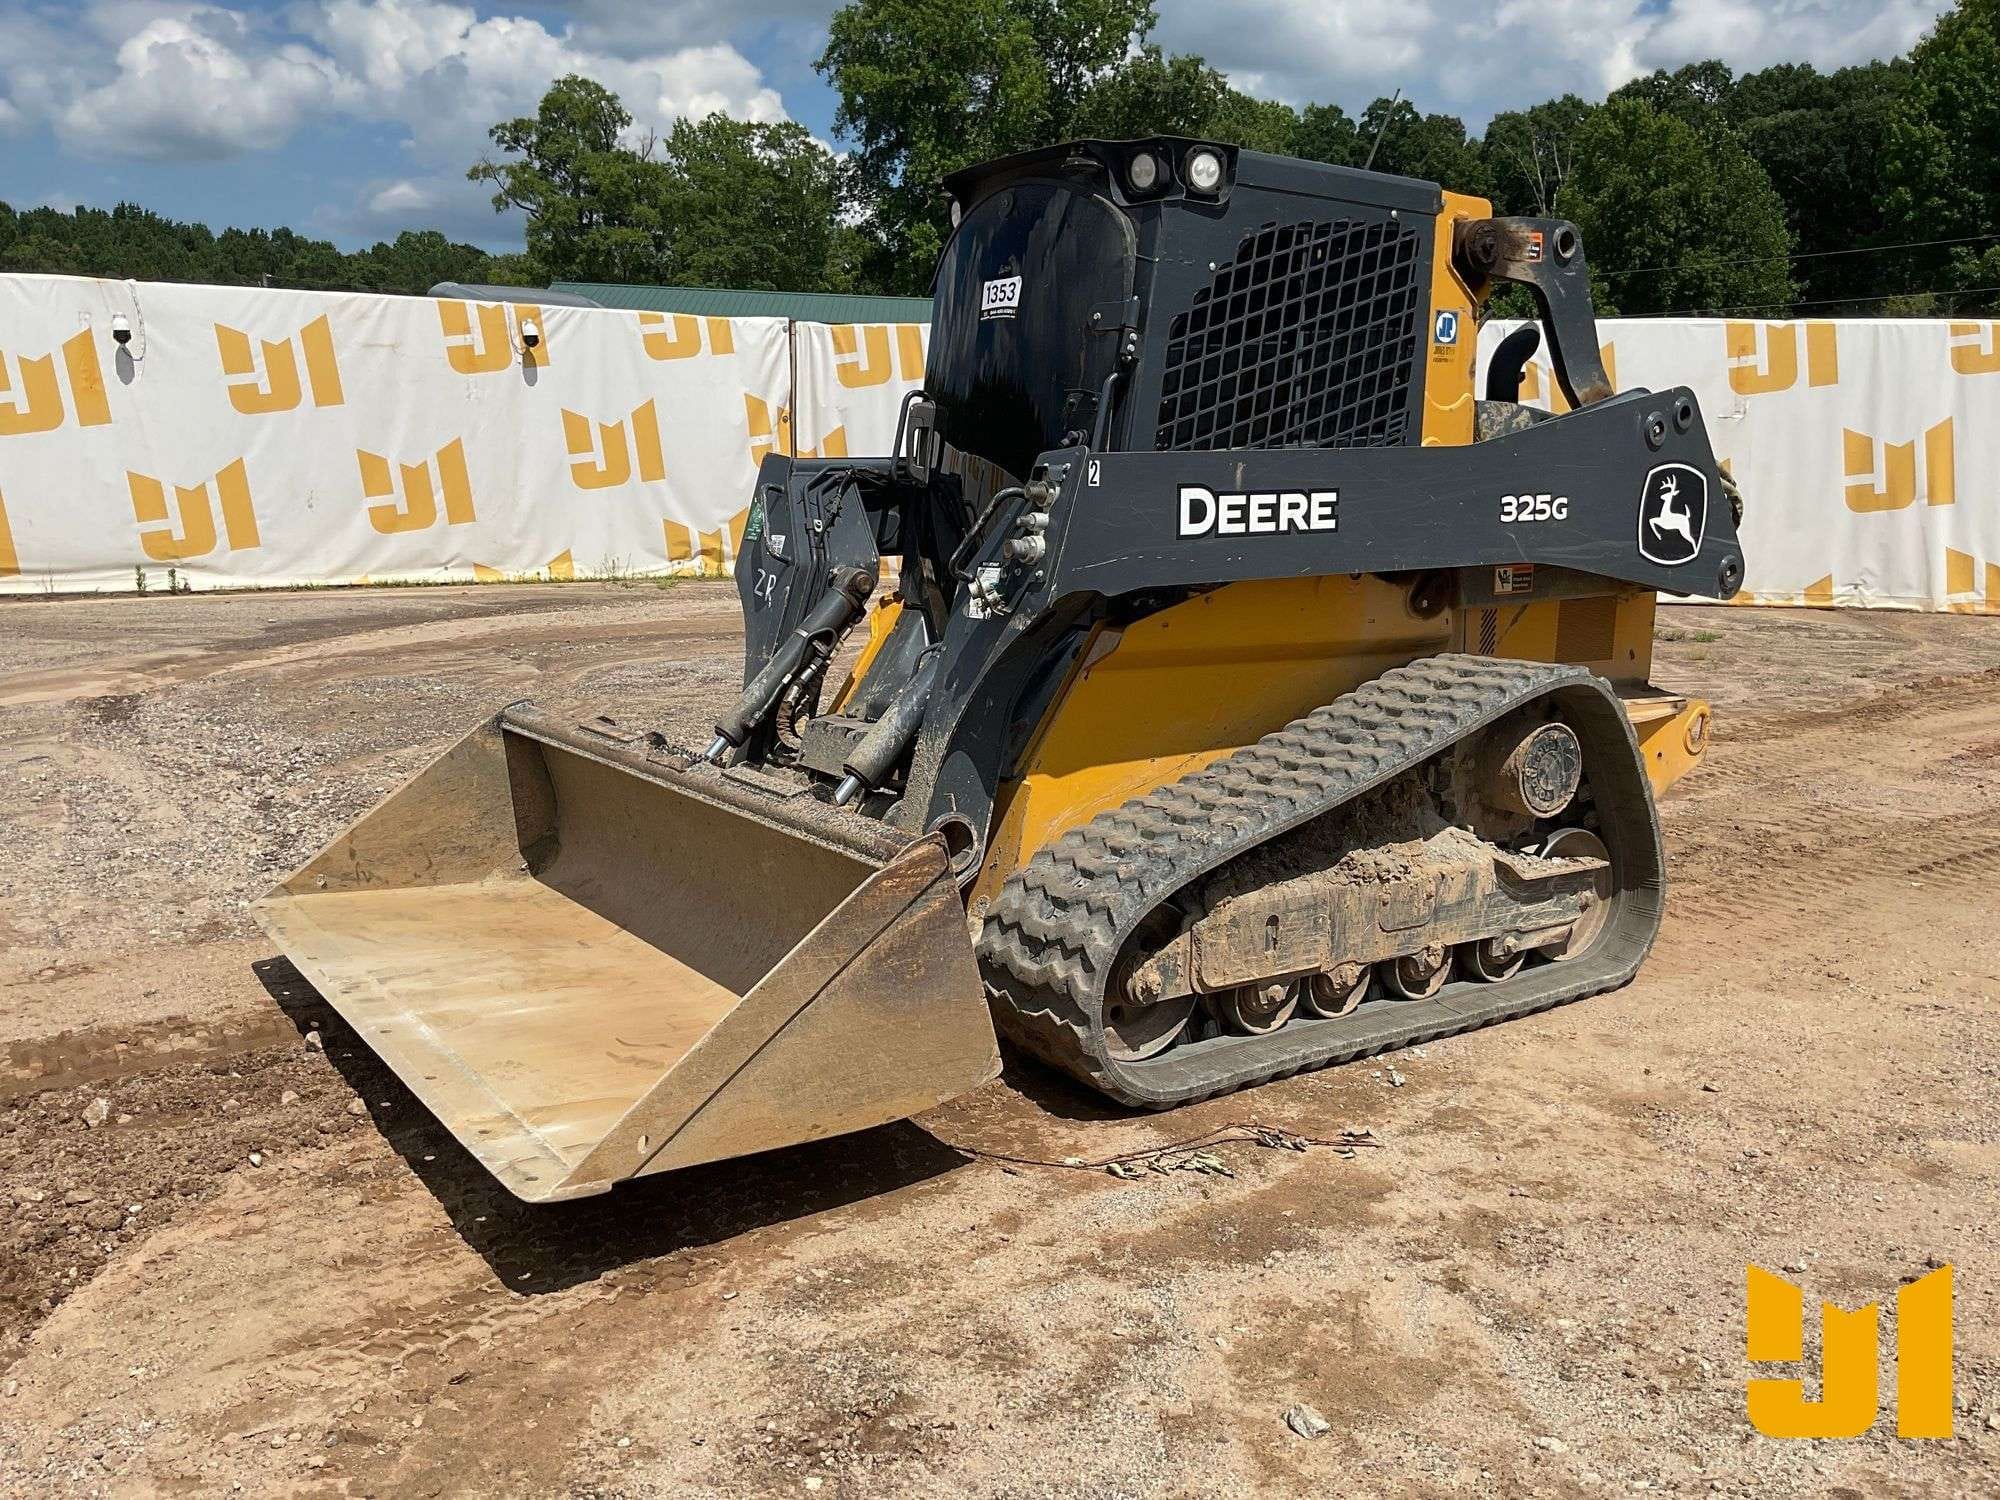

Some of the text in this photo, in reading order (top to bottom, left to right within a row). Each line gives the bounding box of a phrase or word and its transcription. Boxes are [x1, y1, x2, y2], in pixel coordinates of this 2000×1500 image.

[987, 282, 1016, 304] 1353
[1089, 462, 1098, 485] 2
[1179, 487, 1337, 536] DEERE
[1500, 494, 1568, 523] 325G
